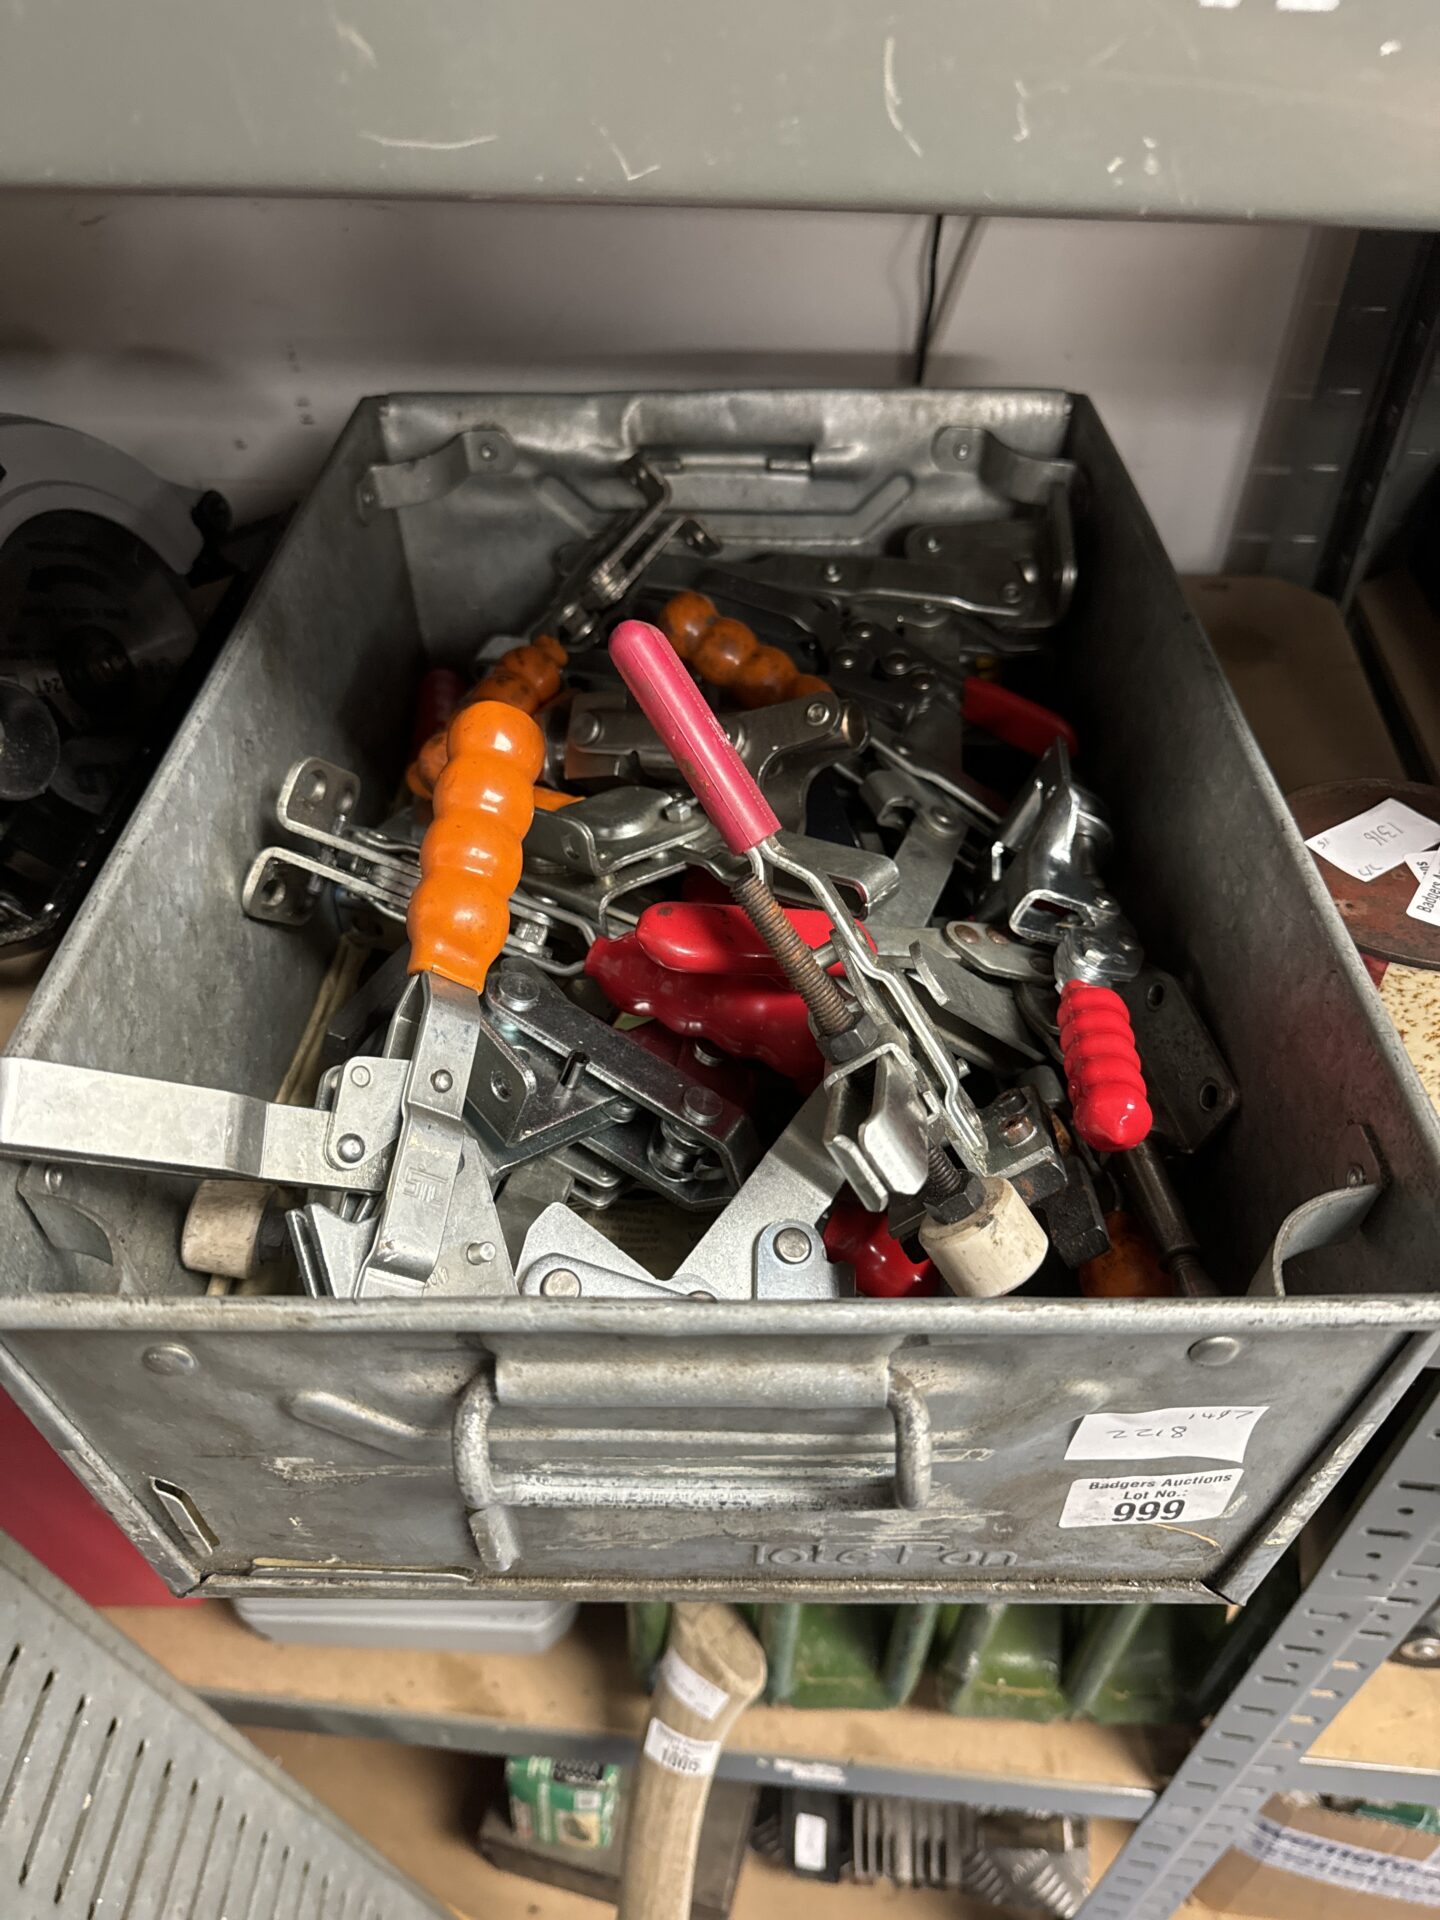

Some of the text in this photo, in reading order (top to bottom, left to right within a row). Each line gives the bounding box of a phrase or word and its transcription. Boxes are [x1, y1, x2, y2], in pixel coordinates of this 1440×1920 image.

[1106, 1425, 1188, 1440] 2218
[1088, 1473, 1233, 1491] Badgers Auctions
[1123, 1490, 1149, 1500] Lot
[1111, 1499, 1186, 1522] 999
